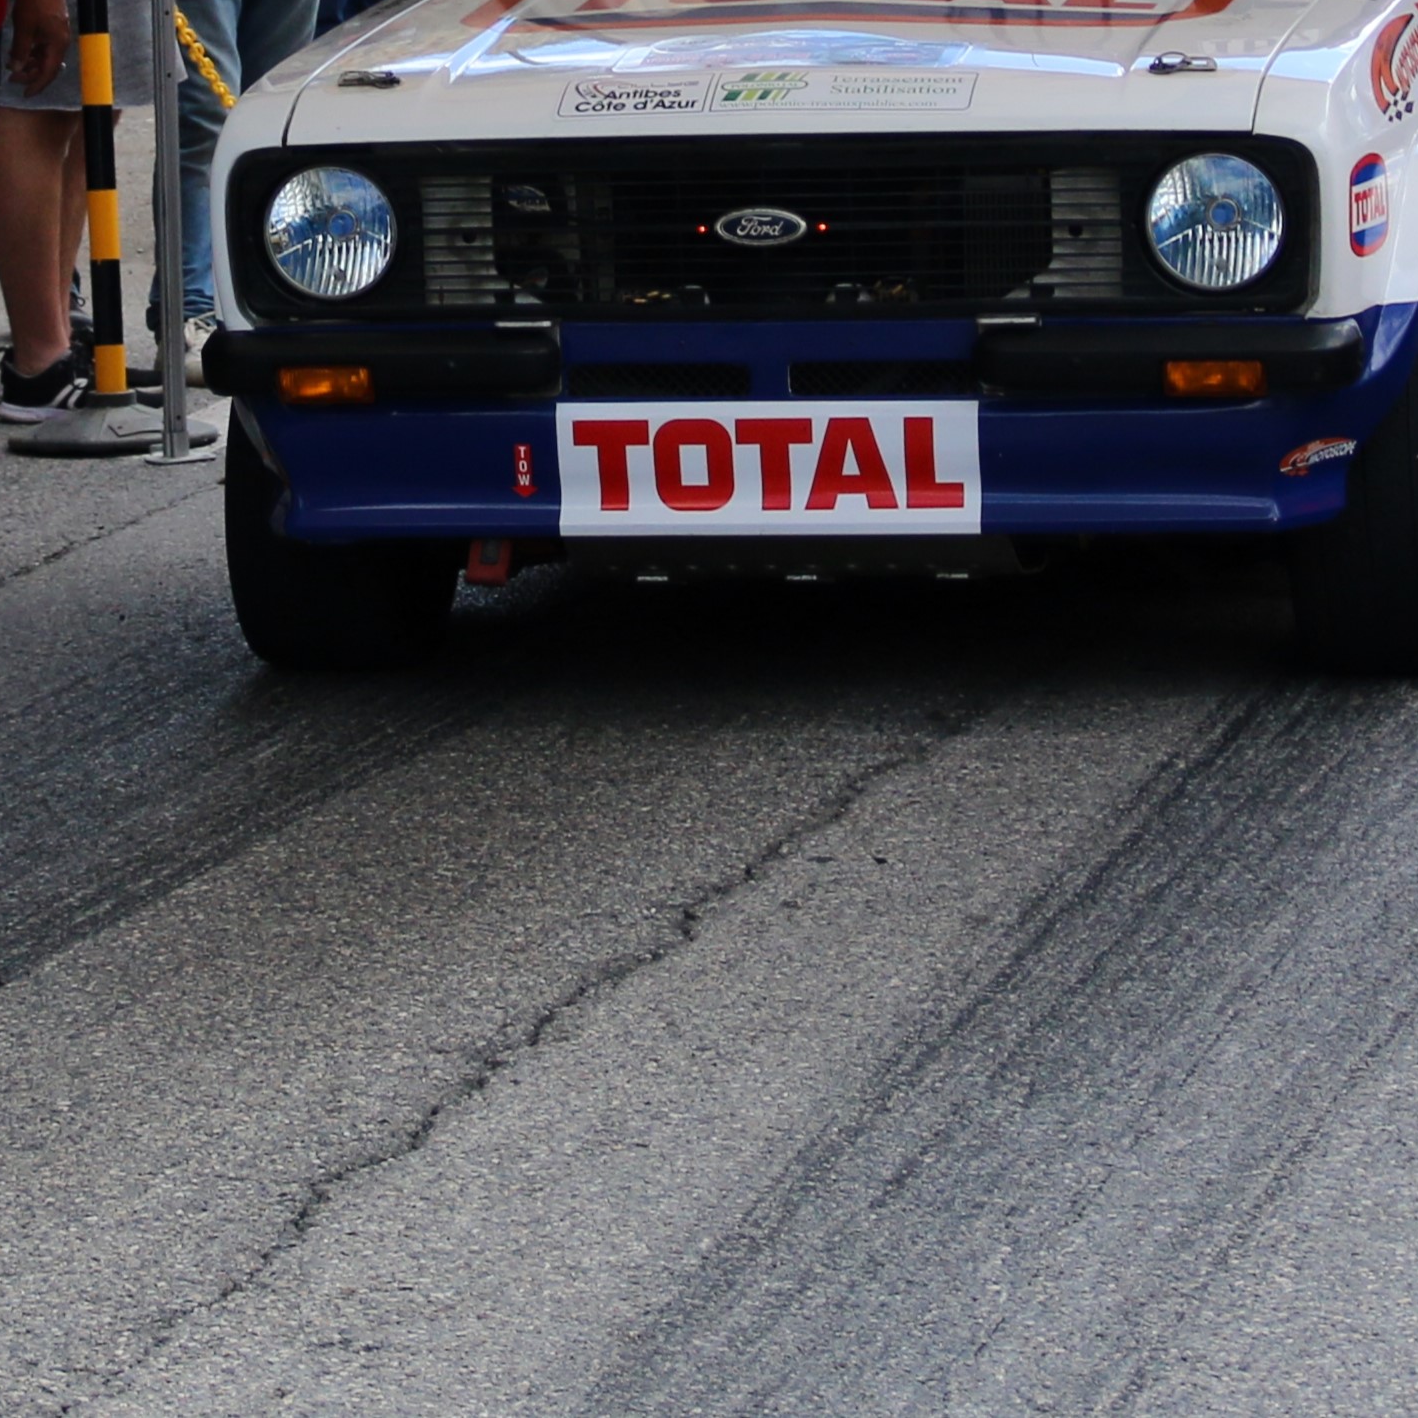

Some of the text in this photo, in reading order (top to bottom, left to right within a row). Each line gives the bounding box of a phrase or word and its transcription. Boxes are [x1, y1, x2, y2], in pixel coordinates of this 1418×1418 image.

[603, 88, 682, 100] Antibes
[830, 84, 957, 95] Stabilisation
[575, 98, 699, 112] Côte d'Azur
[1353, 181, 1386, 227] TOTAL
[735, 217, 784, 237] Ford
[517, 446, 531, 487] TOW
[572, 417, 965, 512] TOTAL
